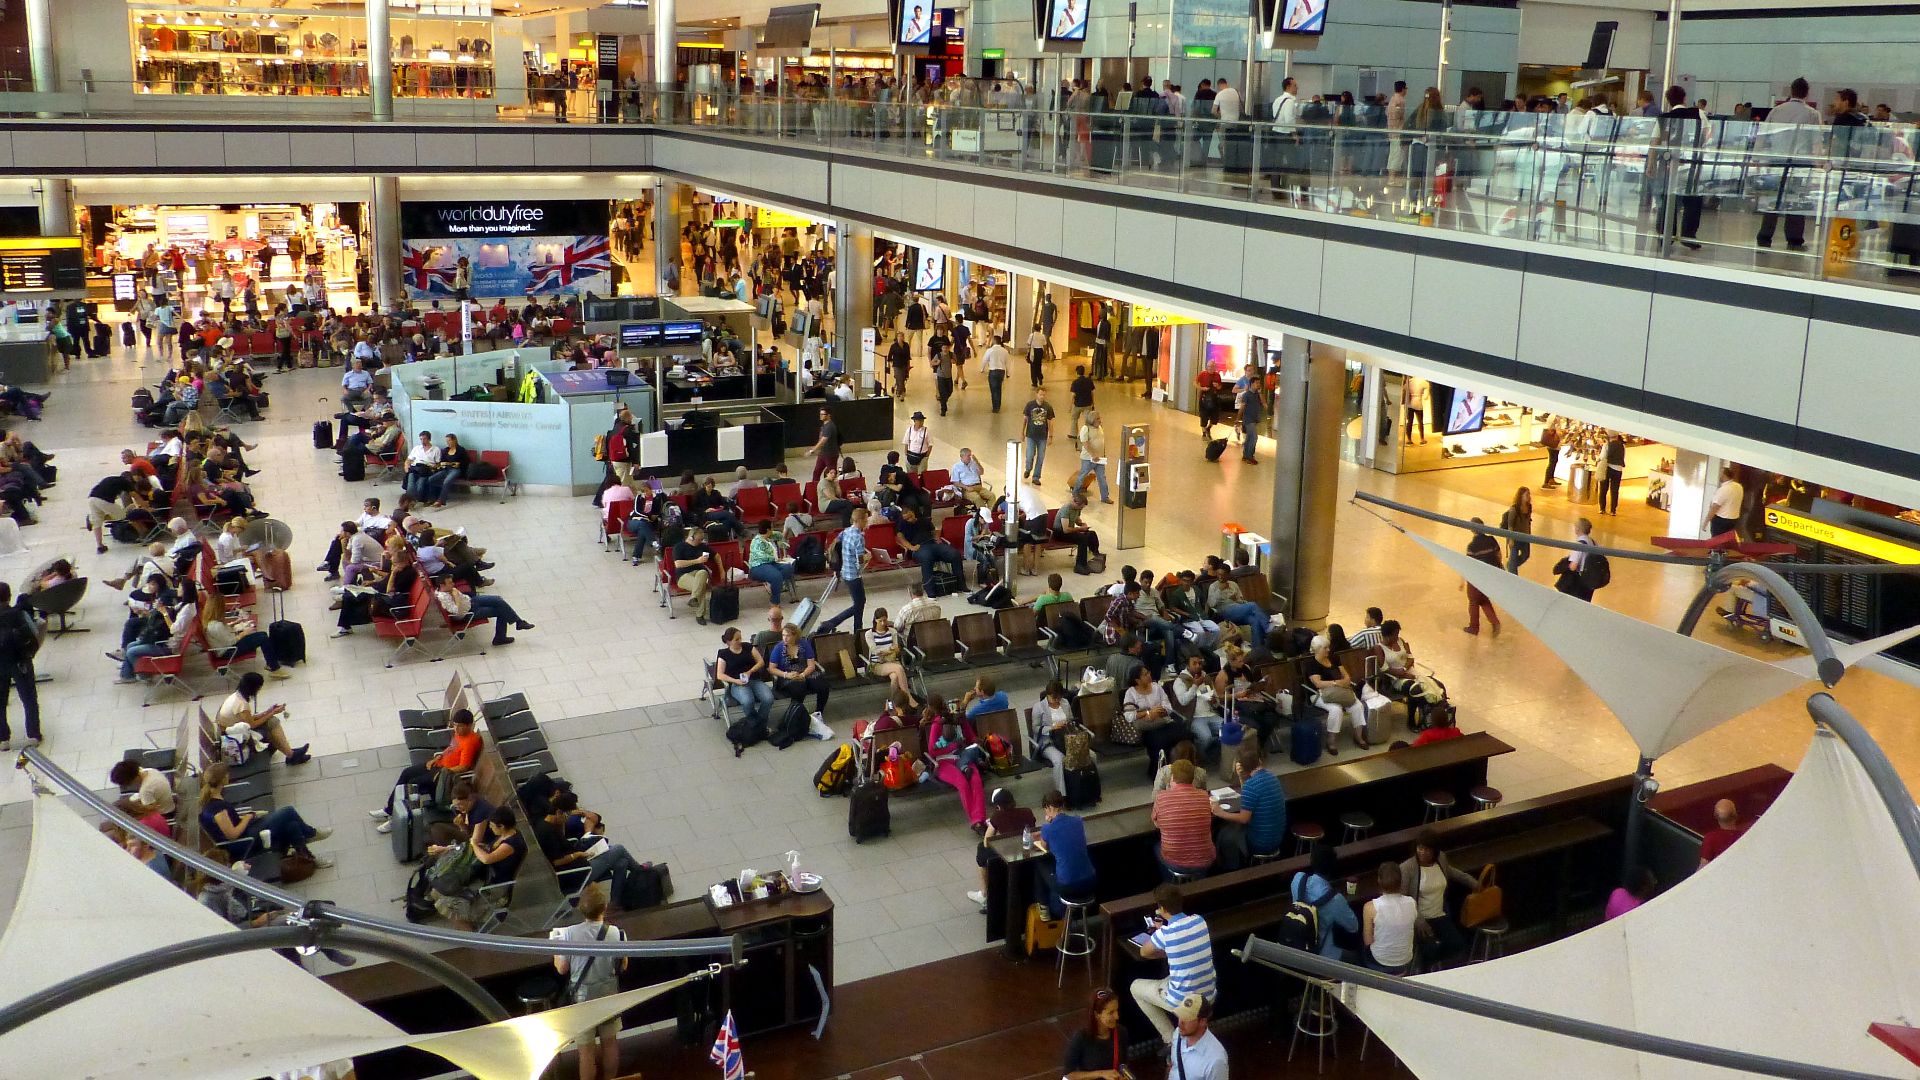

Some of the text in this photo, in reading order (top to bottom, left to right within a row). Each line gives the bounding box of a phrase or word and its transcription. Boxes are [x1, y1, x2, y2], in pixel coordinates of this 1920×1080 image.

[438, 204, 544, 224] worlddutyfree
[449, 225, 468, 233] More
[485, 226, 498, 234] you
[1780, 515, 1835, 539] Departures
